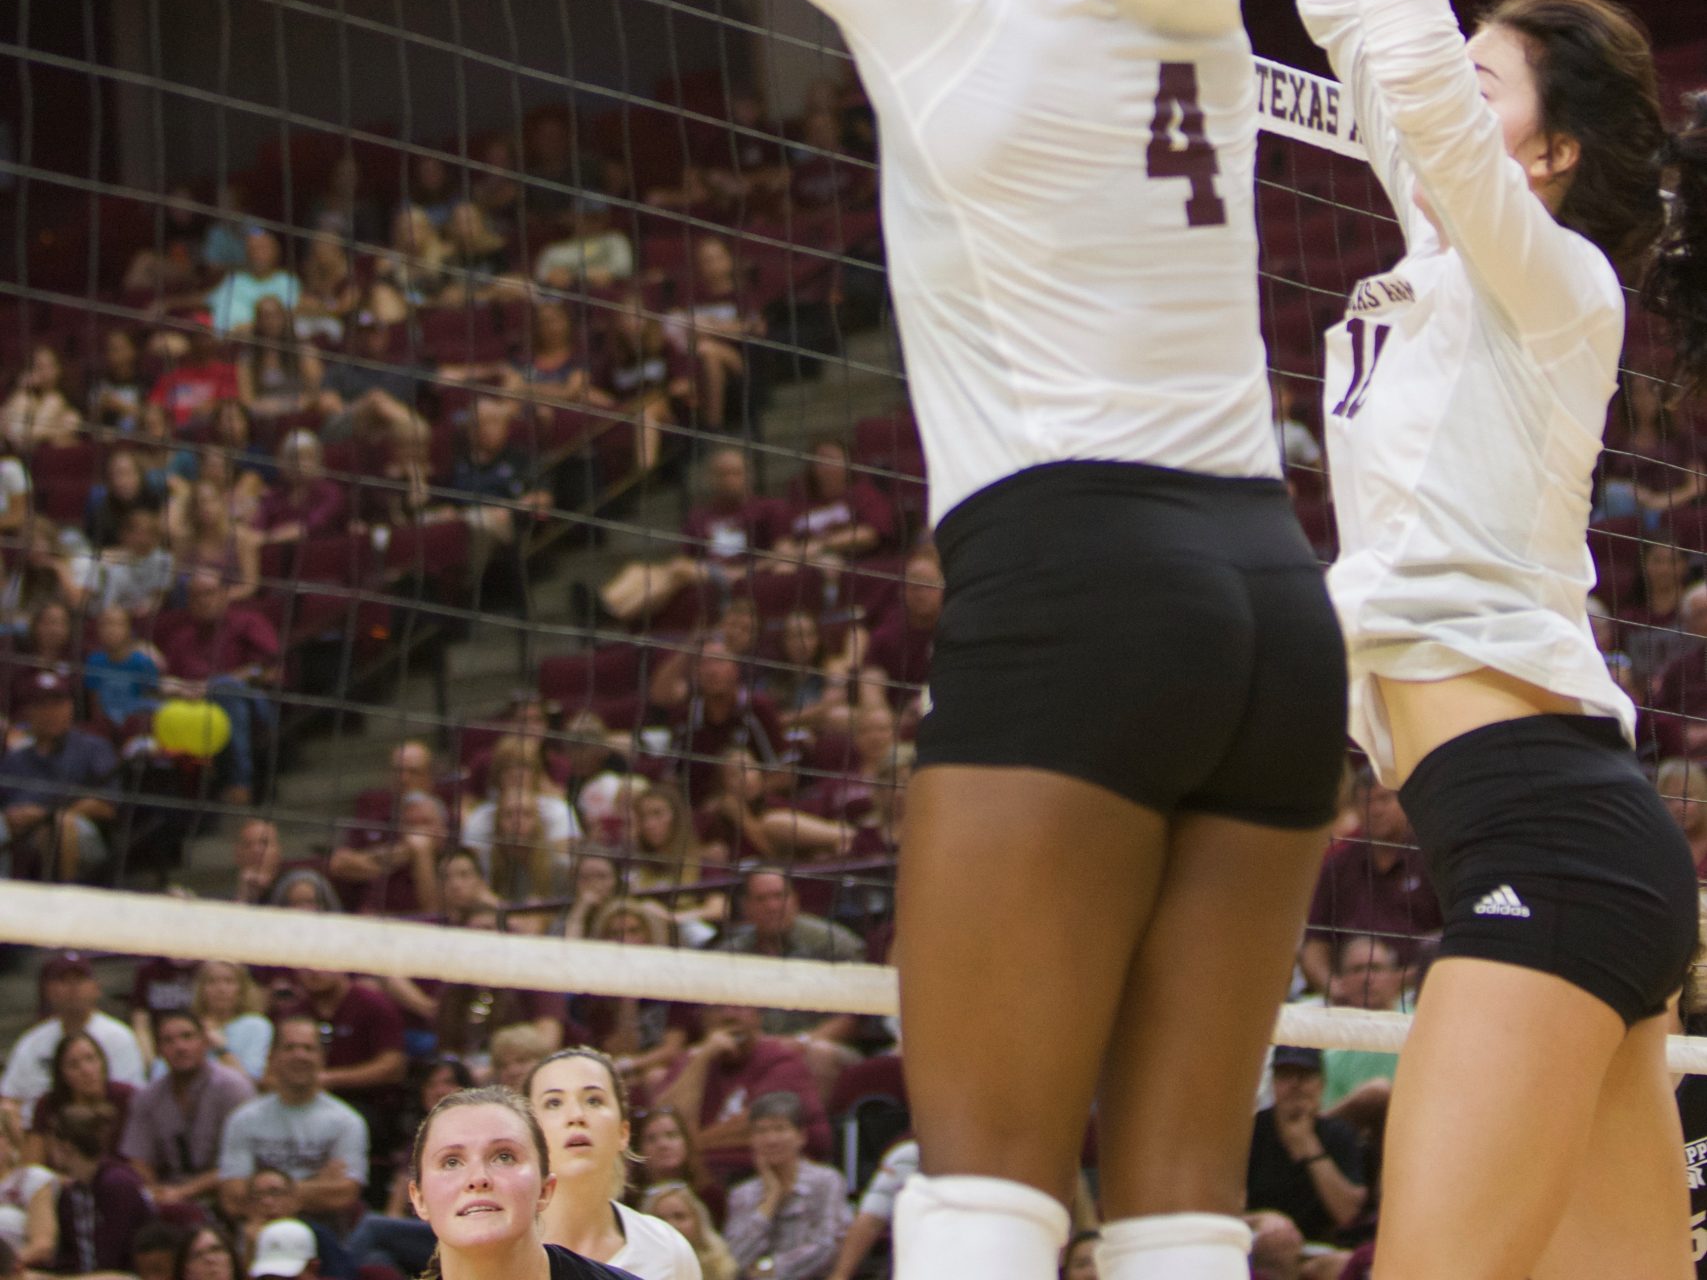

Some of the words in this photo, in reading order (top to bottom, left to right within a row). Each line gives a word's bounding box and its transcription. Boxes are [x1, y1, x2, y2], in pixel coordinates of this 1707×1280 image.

[1254, 61, 1340, 136] TEXAS
[1145, 61, 1228, 228] 4
[1473, 902, 1531, 918] adidas
